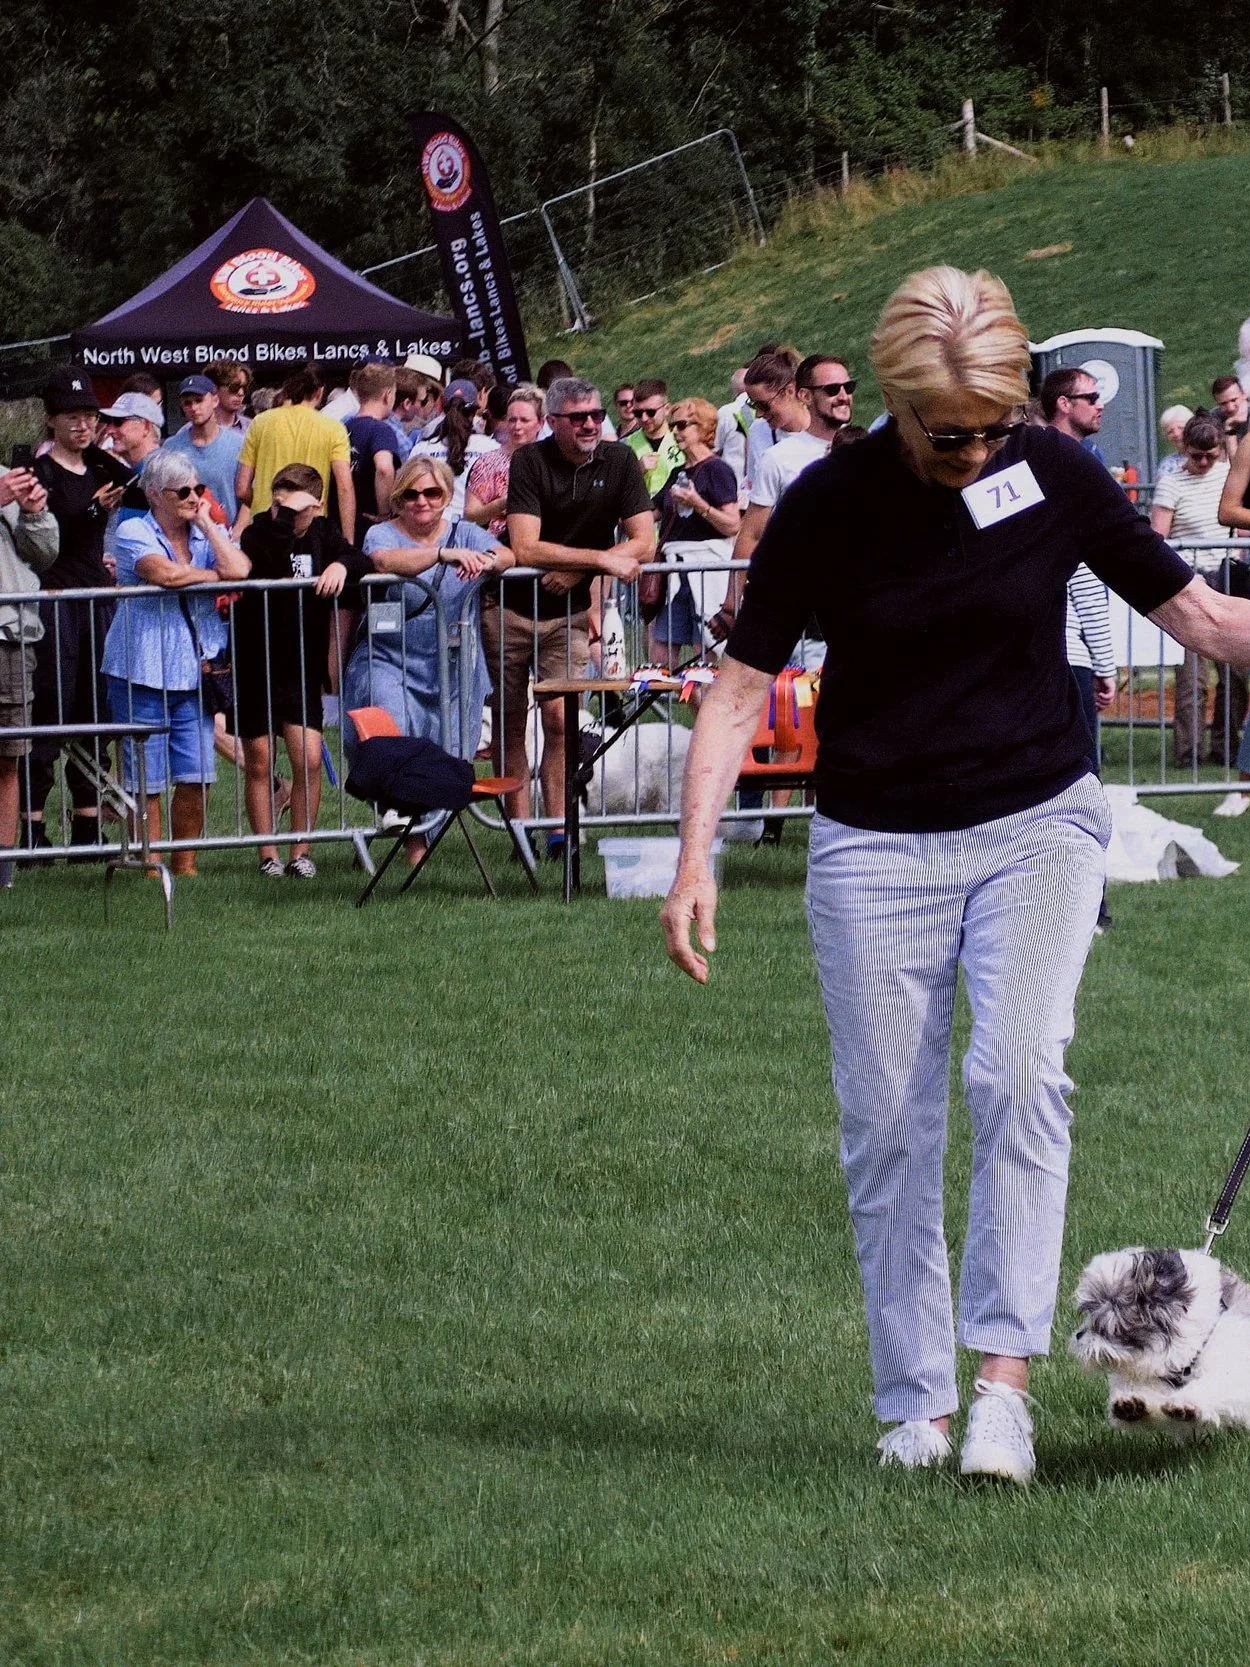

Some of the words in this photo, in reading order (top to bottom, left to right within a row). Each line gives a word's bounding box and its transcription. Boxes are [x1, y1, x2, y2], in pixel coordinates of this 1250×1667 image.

[469, 210, 489, 257] Lakes
[478, 257, 492, 271] &
[484, 271, 501, 318] Lancs
[84, 346, 135, 365] North
[140, 345, 190, 364] West
[194, 343, 249, 363] Blood
[256, 343, 307, 361] Bikes
[313, 341, 369, 360] Lancs
[375, 339, 390, 358] &
[396, 338, 452, 357] Lakes
[494, 316, 513, 361] Bikes
[986, 480, 1021, 508] 71
